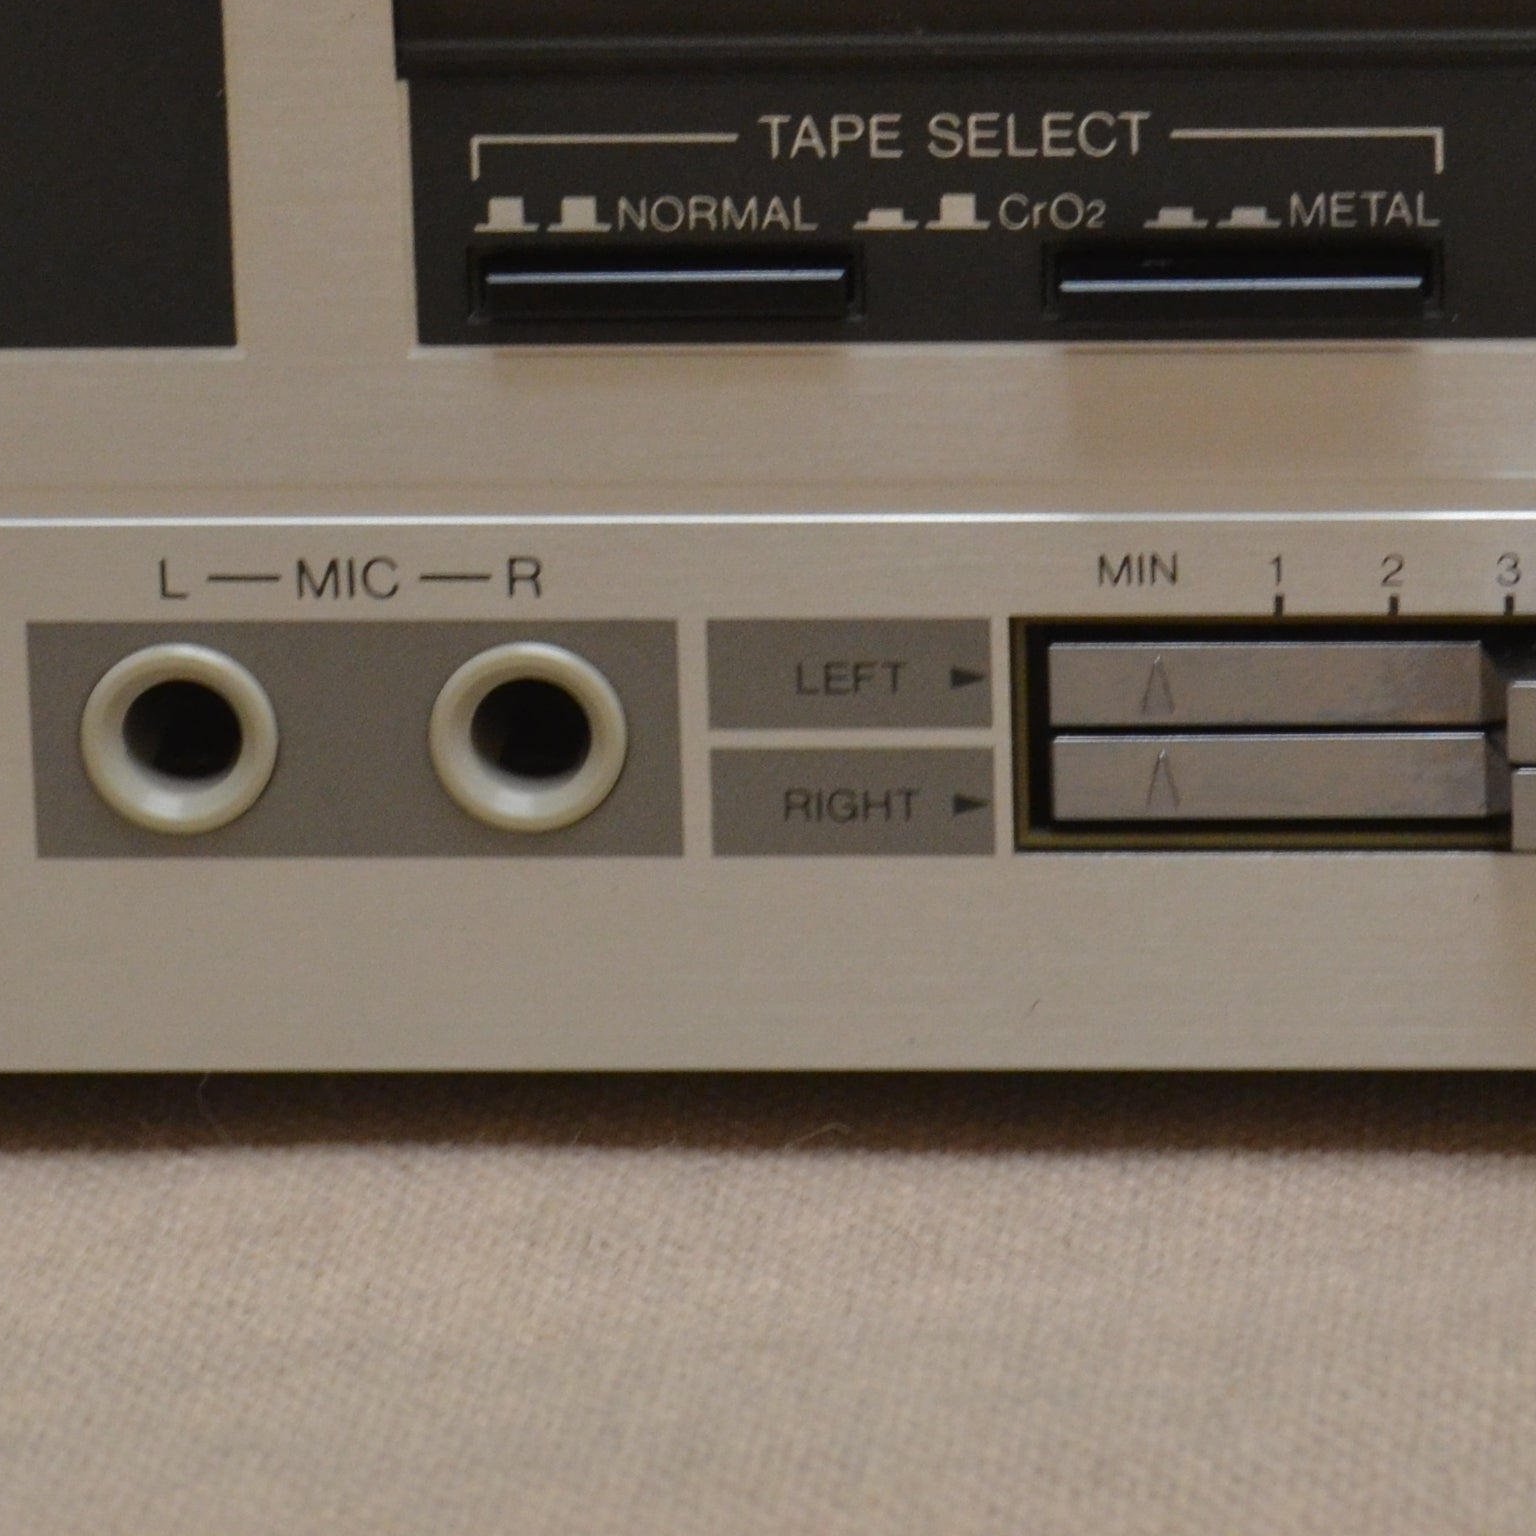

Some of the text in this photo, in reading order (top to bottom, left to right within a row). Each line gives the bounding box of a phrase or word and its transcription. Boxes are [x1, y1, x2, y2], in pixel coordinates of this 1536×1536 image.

[758, 110, 1152, 160] TAPE SELECT
[617, 194, 819, 233] NORMAL
[1289, 190, 1442, 228] METAL
[158, 558, 188, 599] L
[296, 557, 400, 599] MIC
[506, 556, 543, 598] R
[1098, 553, 1179, 585] MIN
[1270, 554, 1284, 583] 1
[1380, 553, 1406, 586] 2
[1496, 552, 1522, 586] 3
[795, 663, 906, 696] LEFT
[784, 788, 921, 822] RIGHT
